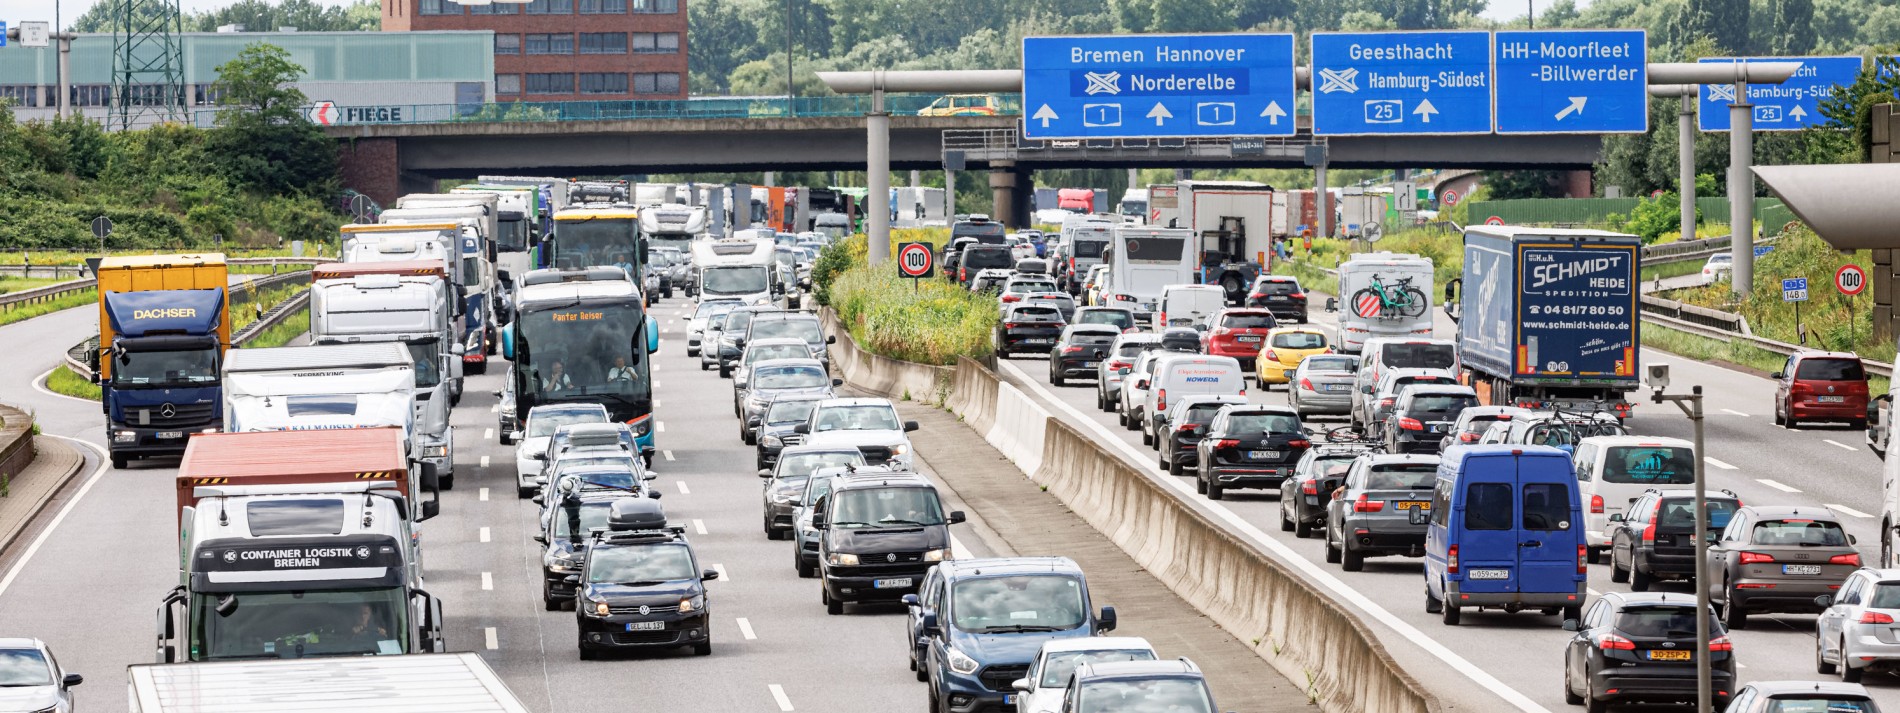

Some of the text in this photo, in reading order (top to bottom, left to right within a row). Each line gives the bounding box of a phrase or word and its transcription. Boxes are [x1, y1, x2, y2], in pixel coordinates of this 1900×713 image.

[1071, 46, 1245, 63] Bremen Hannover
[1349, 43, 1453, 60] Geesthacht
[1502, 42, 1630, 59] HH-Moorfleet
[1531, 65, 1639, 82] -Billwerder
[1131, 74, 1236, 92] Norderelbe
[1369, 71, 1486, 92] Hamburg-Südost
[347, 107, 401, 122] FIEGE
[1099, 108, 1106, 122] 1
[1213, 107, 1219, 121] 1
[1374, 104, 1393, 119] 25
[1761, 108, 1775, 119] 25
[906, 252, 925, 267] 100
[1532, 256, 1622, 288] SCHMIDT
[1589, 277, 1626, 289] HEIDE
[1798, 279, 1805, 288] S
[1841, 272, 1860, 287] 100
[133, 308, 196, 319] DACHSER
[552, 312, 578, 321] Panter
[1543, 305, 1624, 315] 04 81/7 80 50
[1523, 320, 1630, 330] www.schmidt-heide.de
[240, 547, 353, 560] CONTAINER LOGISTIK
[274, 558, 320, 568] BREMEN
